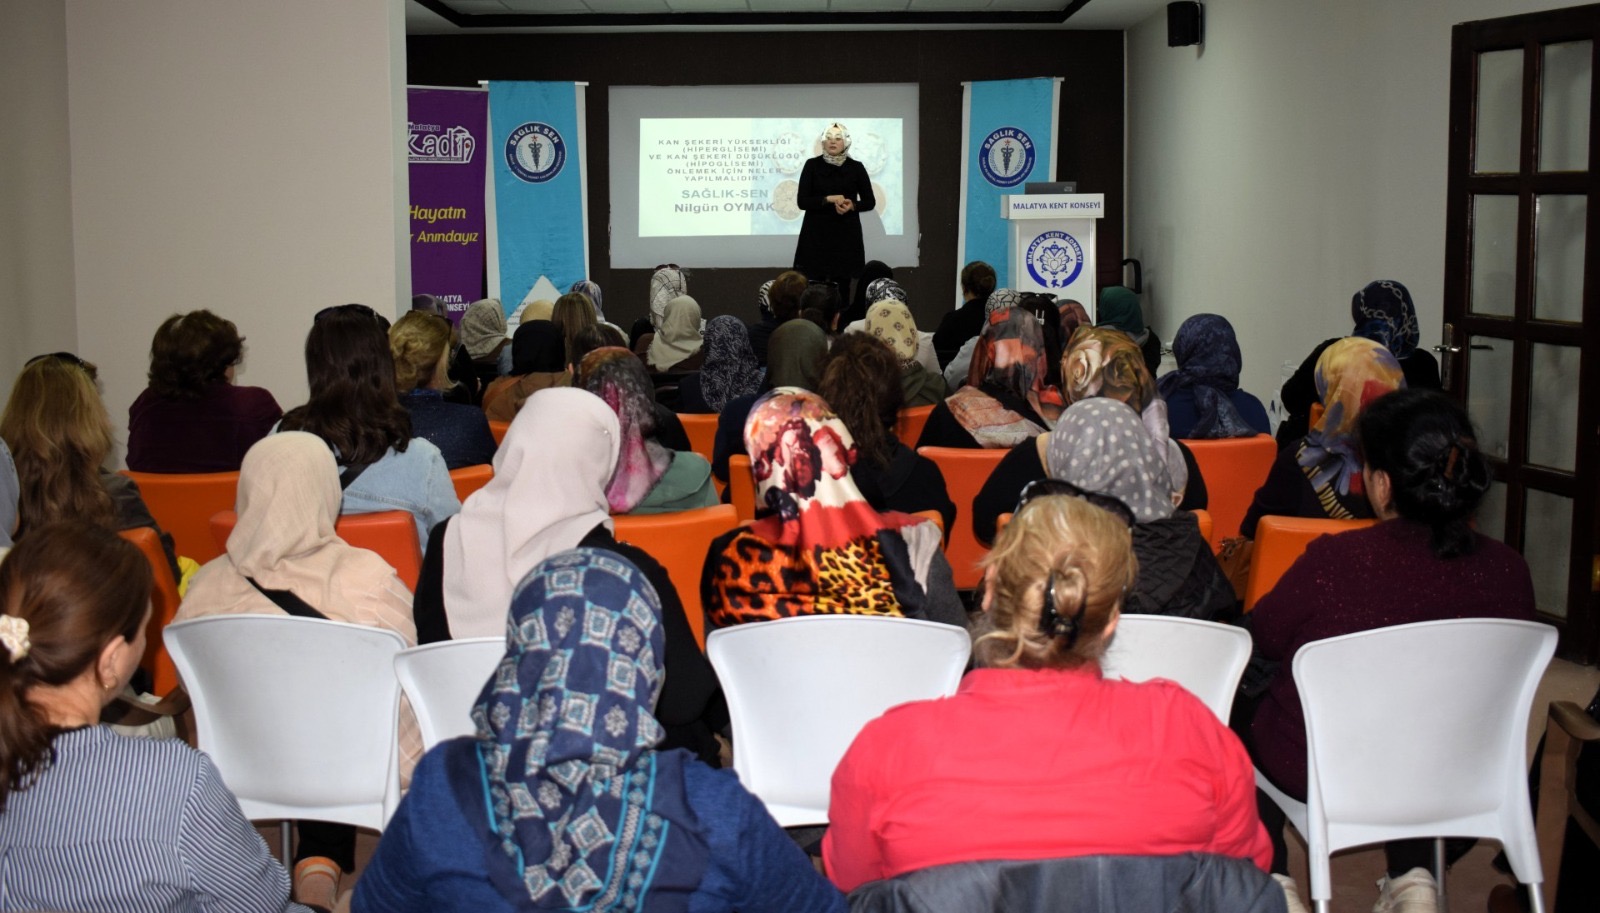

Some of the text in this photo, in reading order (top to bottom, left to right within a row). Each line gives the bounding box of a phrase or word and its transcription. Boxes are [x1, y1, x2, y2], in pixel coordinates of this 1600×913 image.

[543, 127, 560, 144] SEN
[684, 138, 723, 146] ŞEKERİ
[1016, 132, 1032, 150] SEN
[693, 153, 731, 161] ŞEKERİ
[682, 188, 768, 198] SAĞLIK-SEN
[409, 205, 466, 224] Hayatın
[674, 202, 774, 213] Nilgün OYMAK
[416, 230, 478, 245] Anındayız
[1027, 236, 1045, 265] MALATYA
